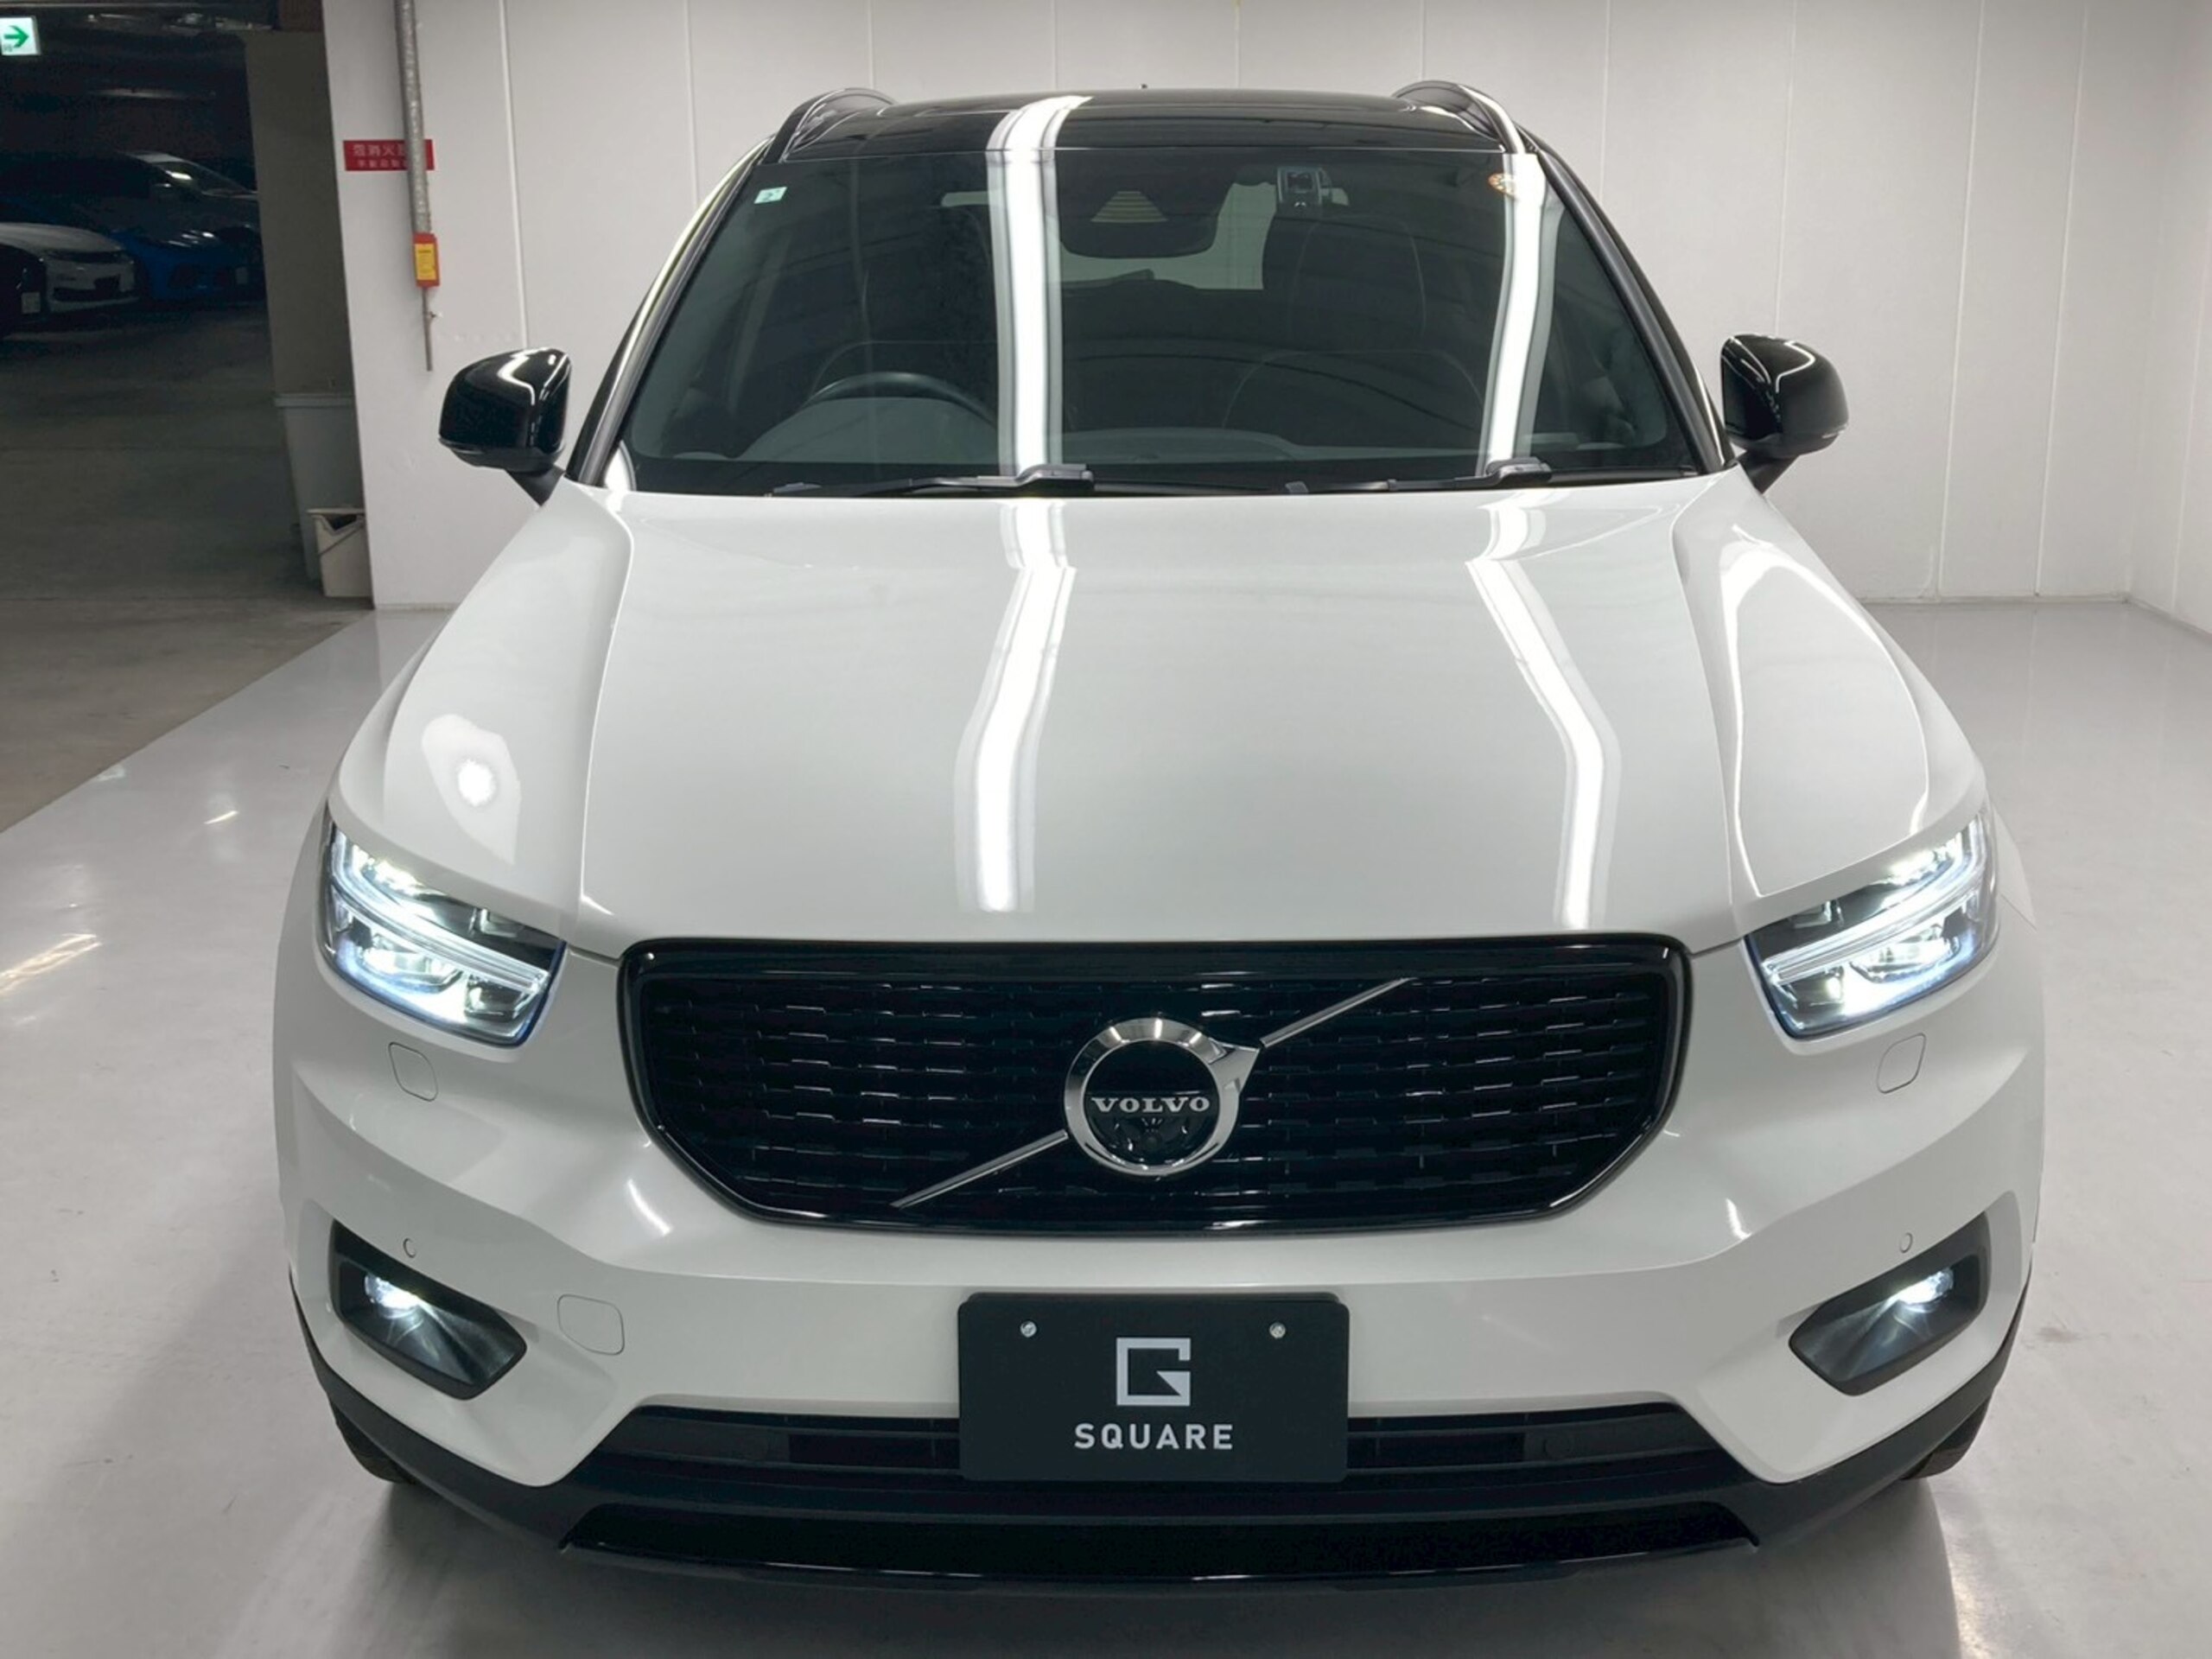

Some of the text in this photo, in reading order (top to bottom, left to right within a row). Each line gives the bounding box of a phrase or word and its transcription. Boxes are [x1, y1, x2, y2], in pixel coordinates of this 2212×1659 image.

[1090, 1096, 1210, 1113] VOLVO
[1116, 1338, 1192, 1407] G
[1074, 1423, 1233, 1450] SQUARE
